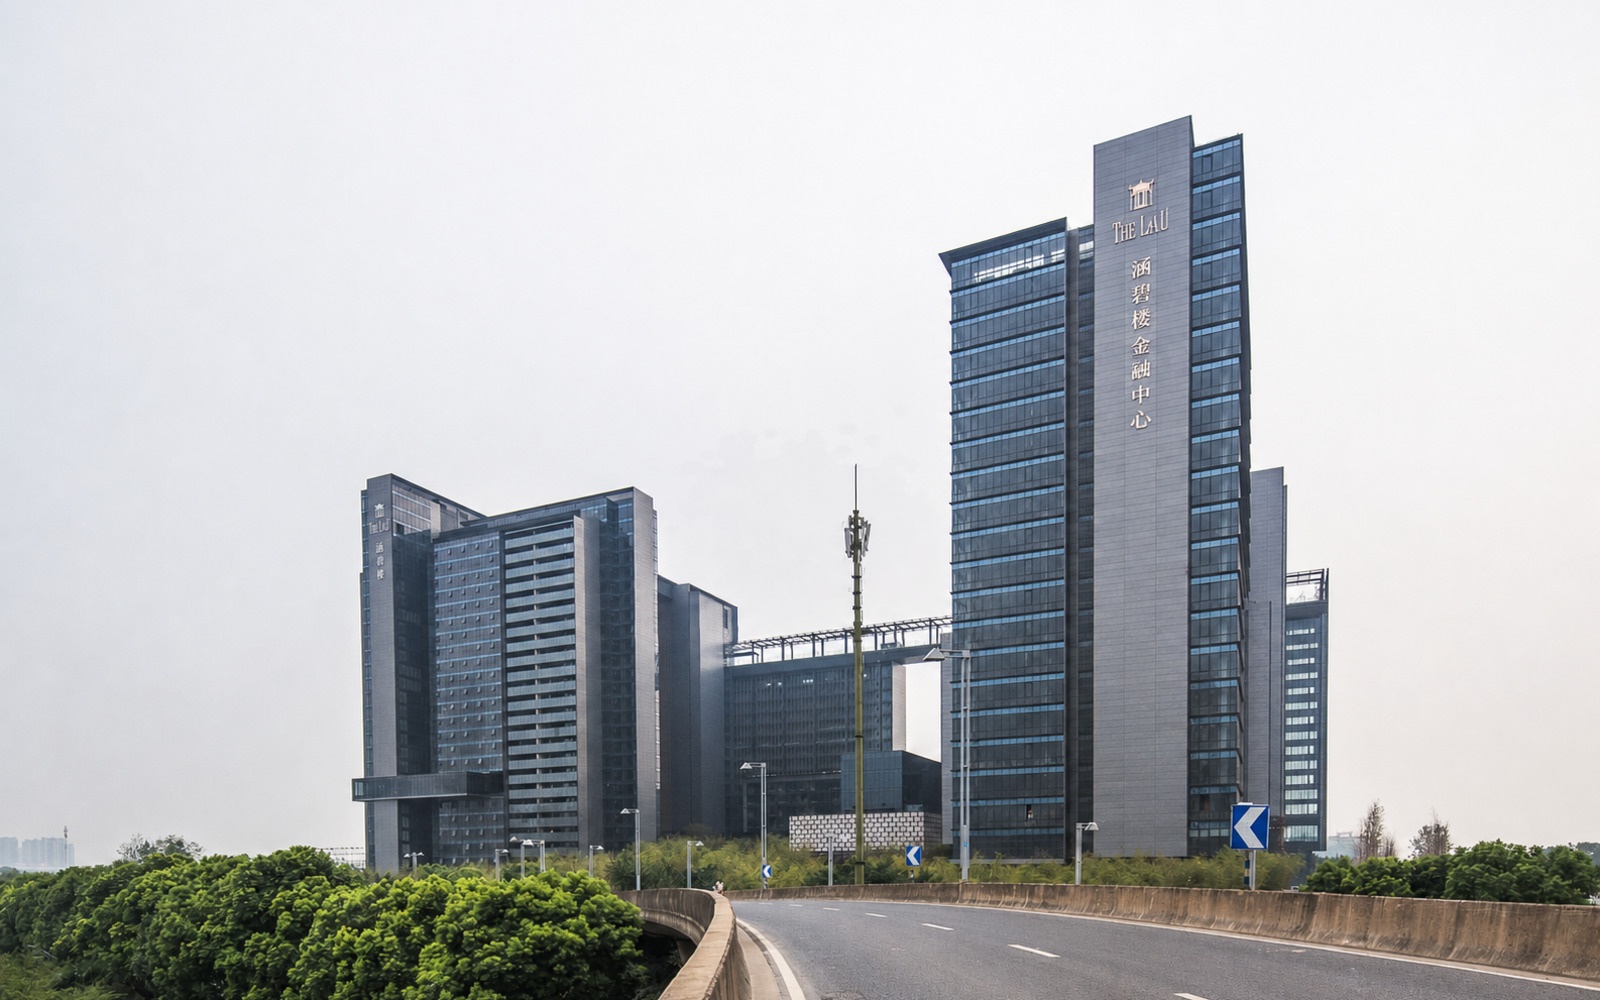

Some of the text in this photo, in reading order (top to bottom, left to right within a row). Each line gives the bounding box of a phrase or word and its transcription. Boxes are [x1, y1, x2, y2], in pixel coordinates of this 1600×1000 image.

[1112, 208, 1169, 244] THE LAU
[1131, 256, 1152, 430] 涵碧楼金融中心
